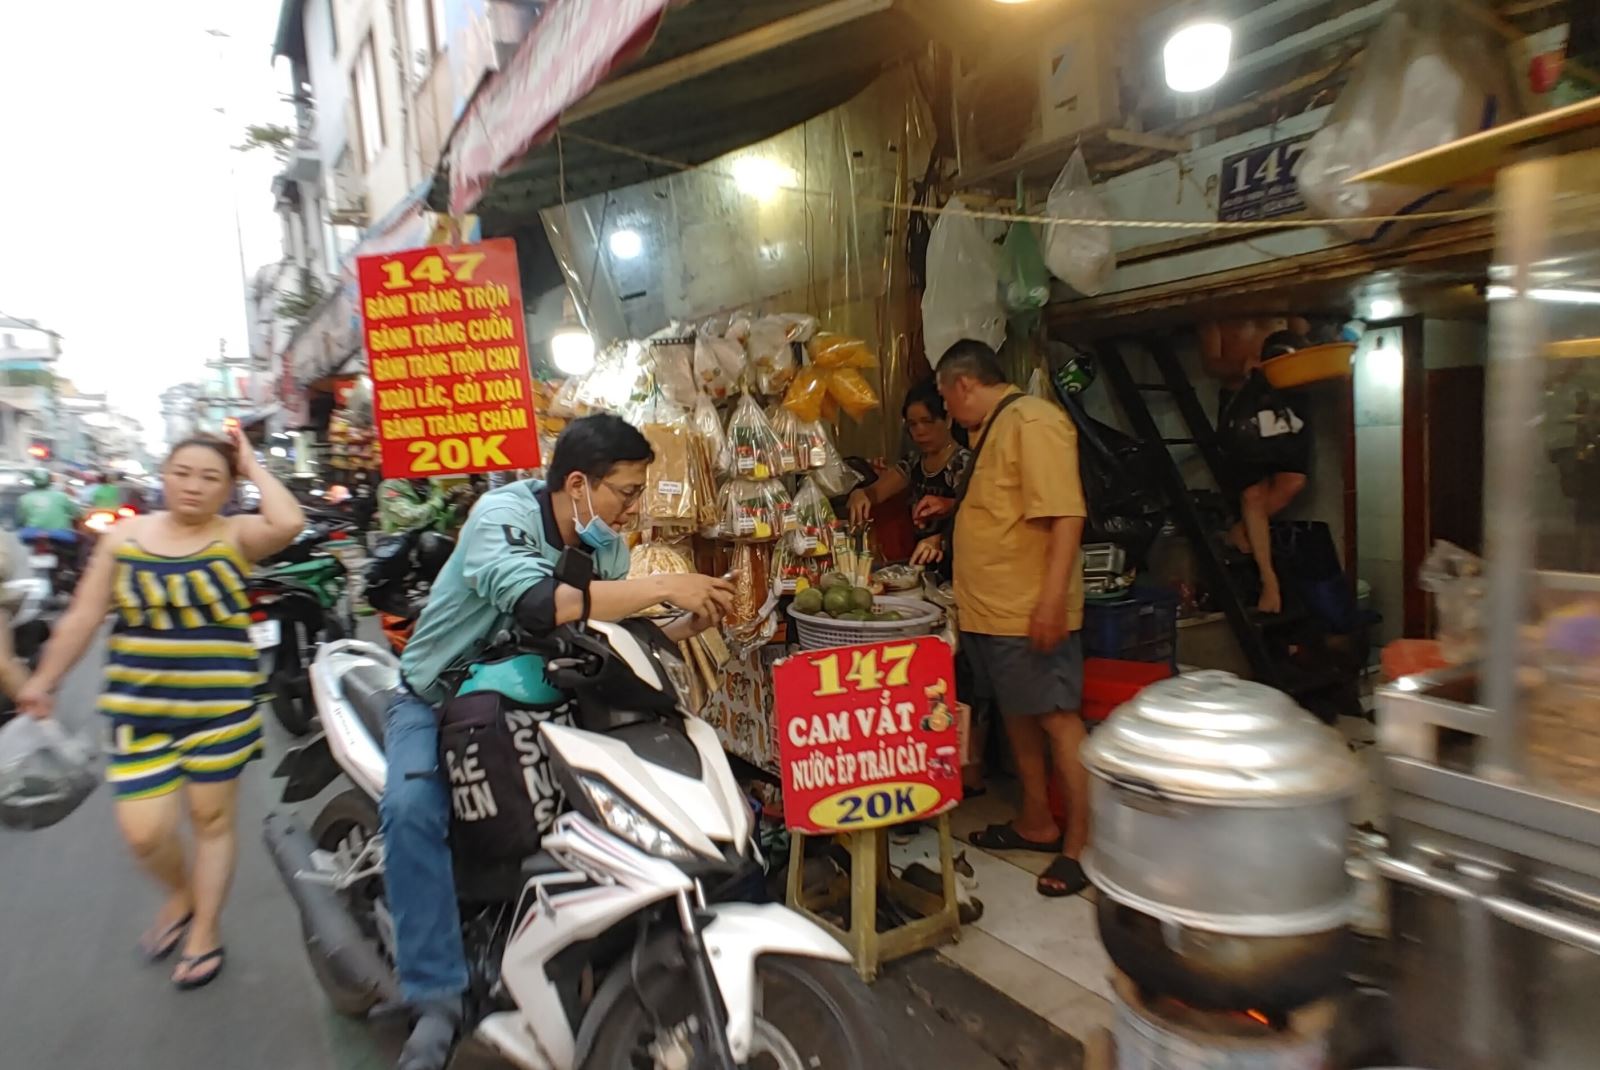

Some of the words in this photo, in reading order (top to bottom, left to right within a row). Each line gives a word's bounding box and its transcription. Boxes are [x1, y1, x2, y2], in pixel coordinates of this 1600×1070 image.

[381, 253, 486, 289] 147
[487, 346, 521, 371] CHAY
[485, 374, 523, 400] XOÀI
[408, 435, 512, 472] 20K
[808, 642, 918, 697] 147
[788, 710, 850, 747] CAM
[791, 749, 834, 791] NƯỚC
[835, 746, 857, 785] ÉP
[857, 740, 896, 781] TRÁI
[896, 736, 928, 775] CÂY
[836, 786, 916, 825] 20K
